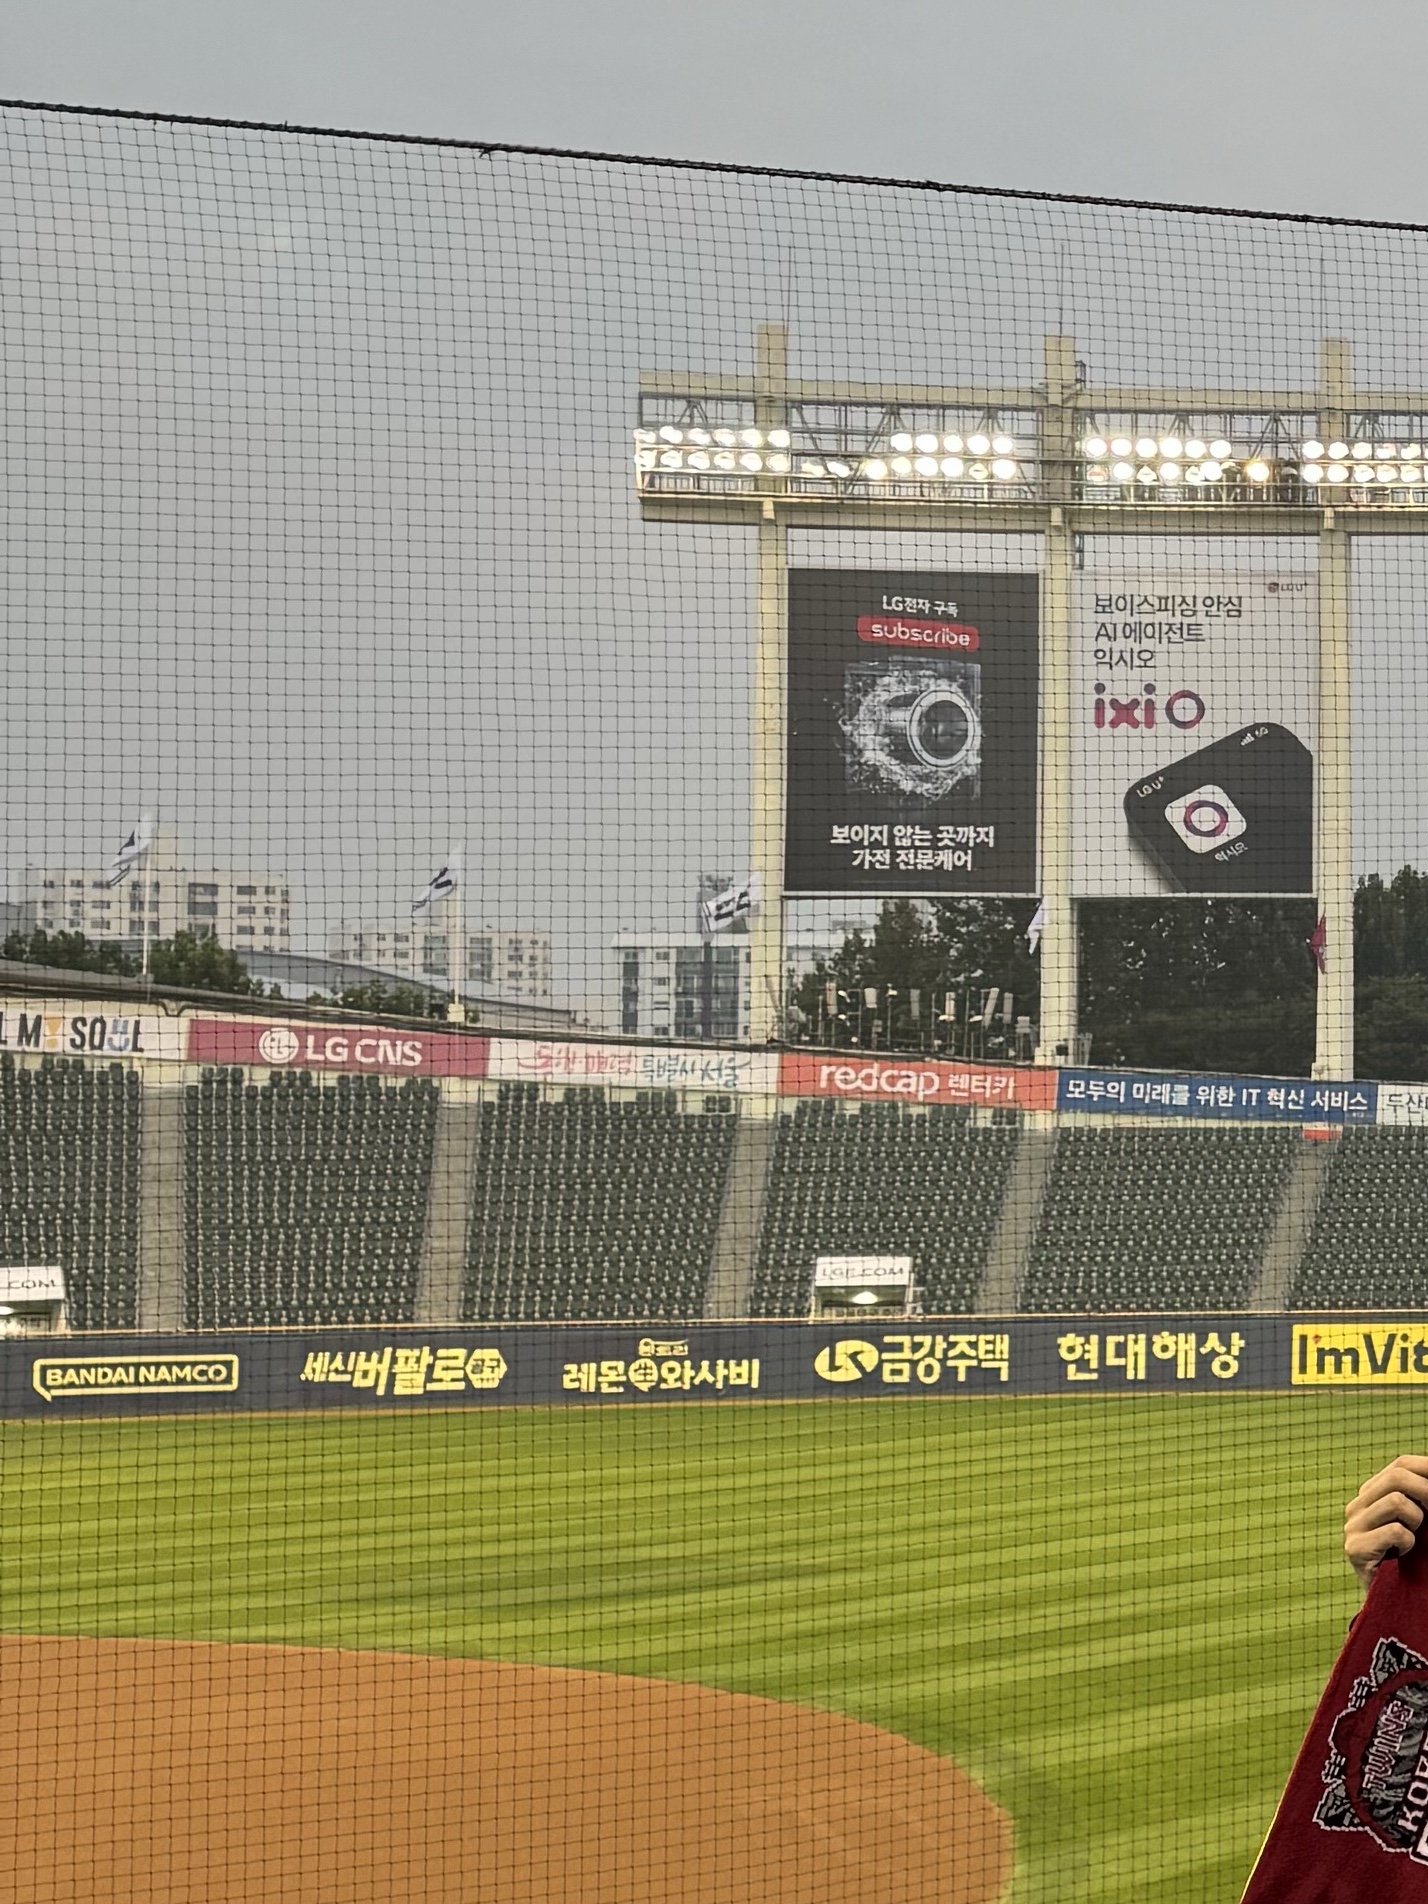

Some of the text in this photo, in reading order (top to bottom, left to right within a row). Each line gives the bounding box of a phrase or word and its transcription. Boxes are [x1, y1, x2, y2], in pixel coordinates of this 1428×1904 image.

[882, 595, 931, 614] LG전자
[1094, 595, 1243, 618] 보이스피싱 안심
[871, 622, 970, 646] subscribe
[1095, 621, 1205, 644] AI 에이전트
[1094, 647, 1157, 670] 익시오
[830, 824, 994, 847] 보이지 않는 곳까지
[852, 849, 972, 871] 가전 전문케어
[306, 1034, 424, 1068] LG CNS
[819, 1062, 1016, 1100] redcap 렌터카
[1066, 1079, 1368, 1112] 모두의 미래를 위한 IT 혁신 서비스
[881, 1335, 1010, 1384] 금강주택
[1057, 1331, 1246, 1381] 현대해상
[47, 1364, 227, 1386] BANDAI NAMCO
[300, 1346, 466, 1395] 세신버팔로
[1362, 1700, 1416, 1794] TWINS
